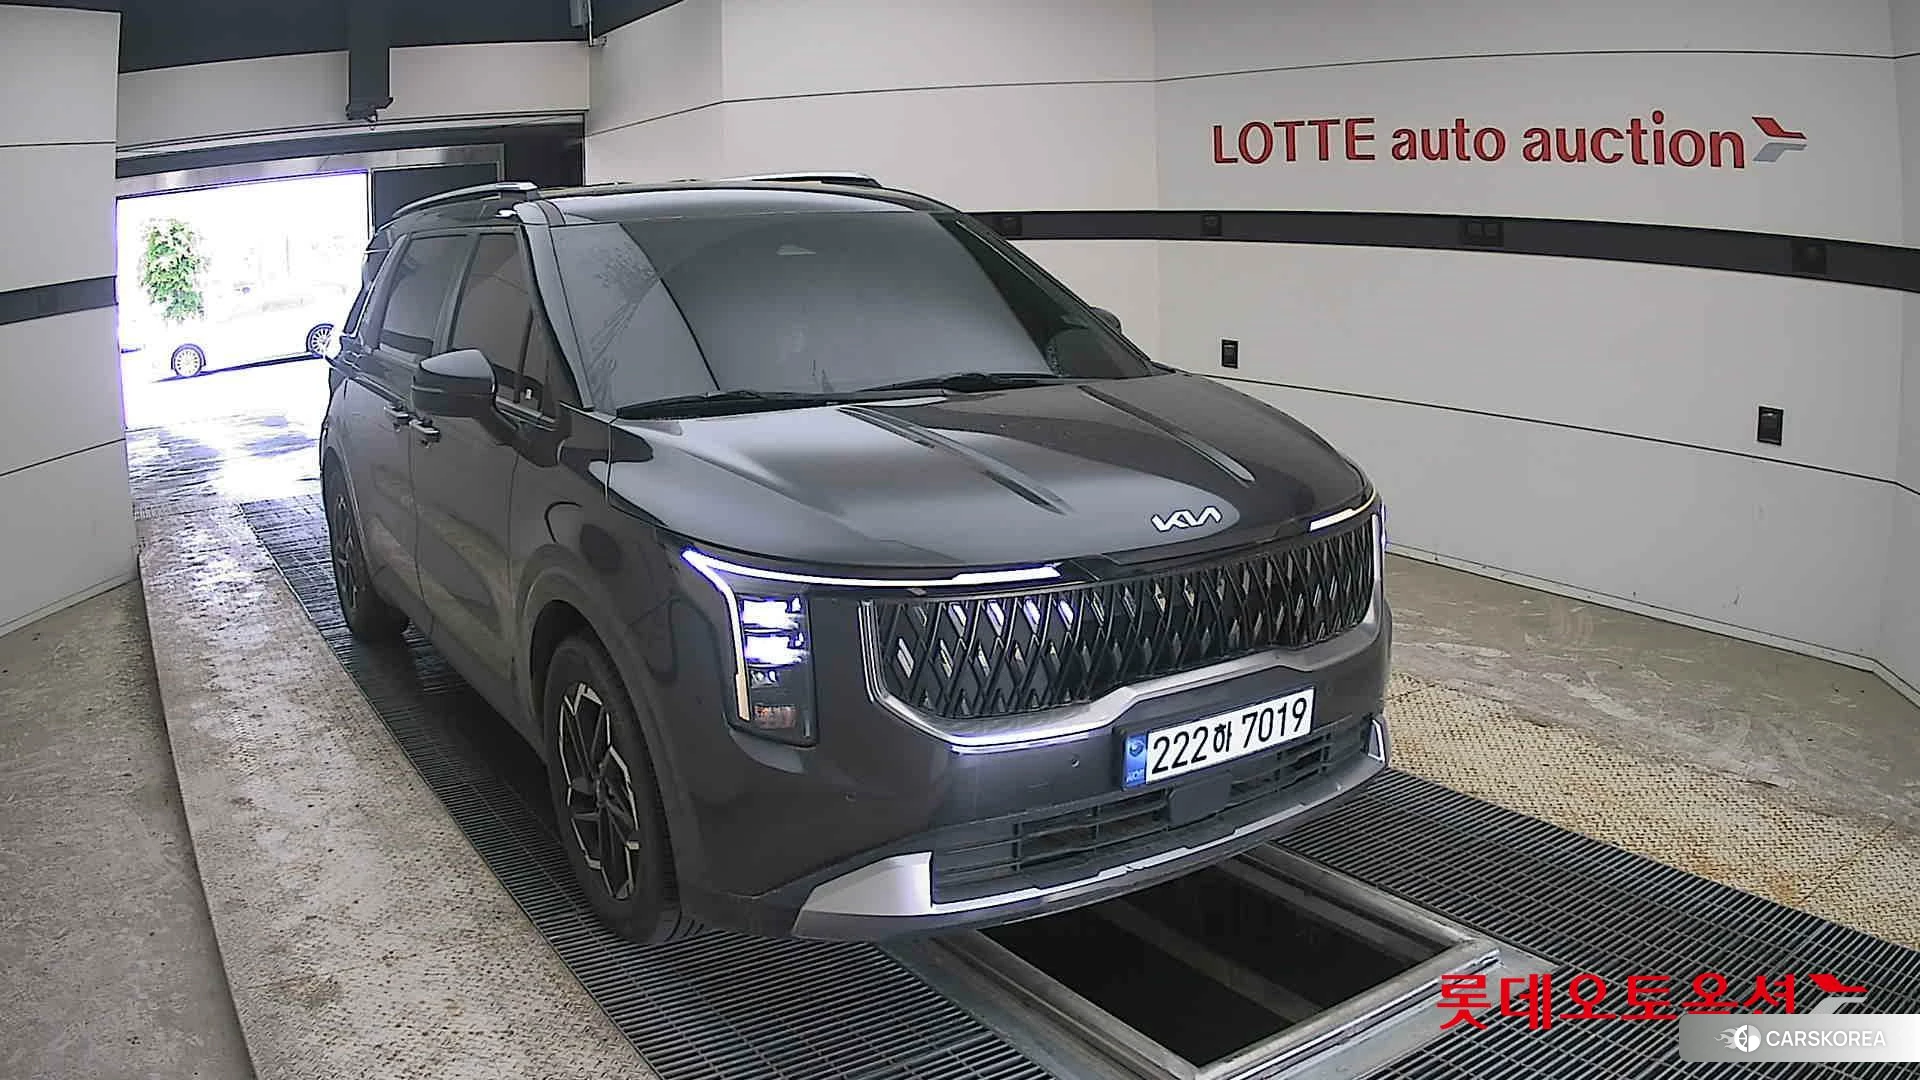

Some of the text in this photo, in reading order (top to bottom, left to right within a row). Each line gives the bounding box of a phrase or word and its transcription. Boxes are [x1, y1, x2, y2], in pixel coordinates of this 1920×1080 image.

[1213, 110, 1746, 169] LOTTE auto auction
[1151, 506, 1223, 532] KIA
[1151, 697, 1308, 775] 222하 7019
